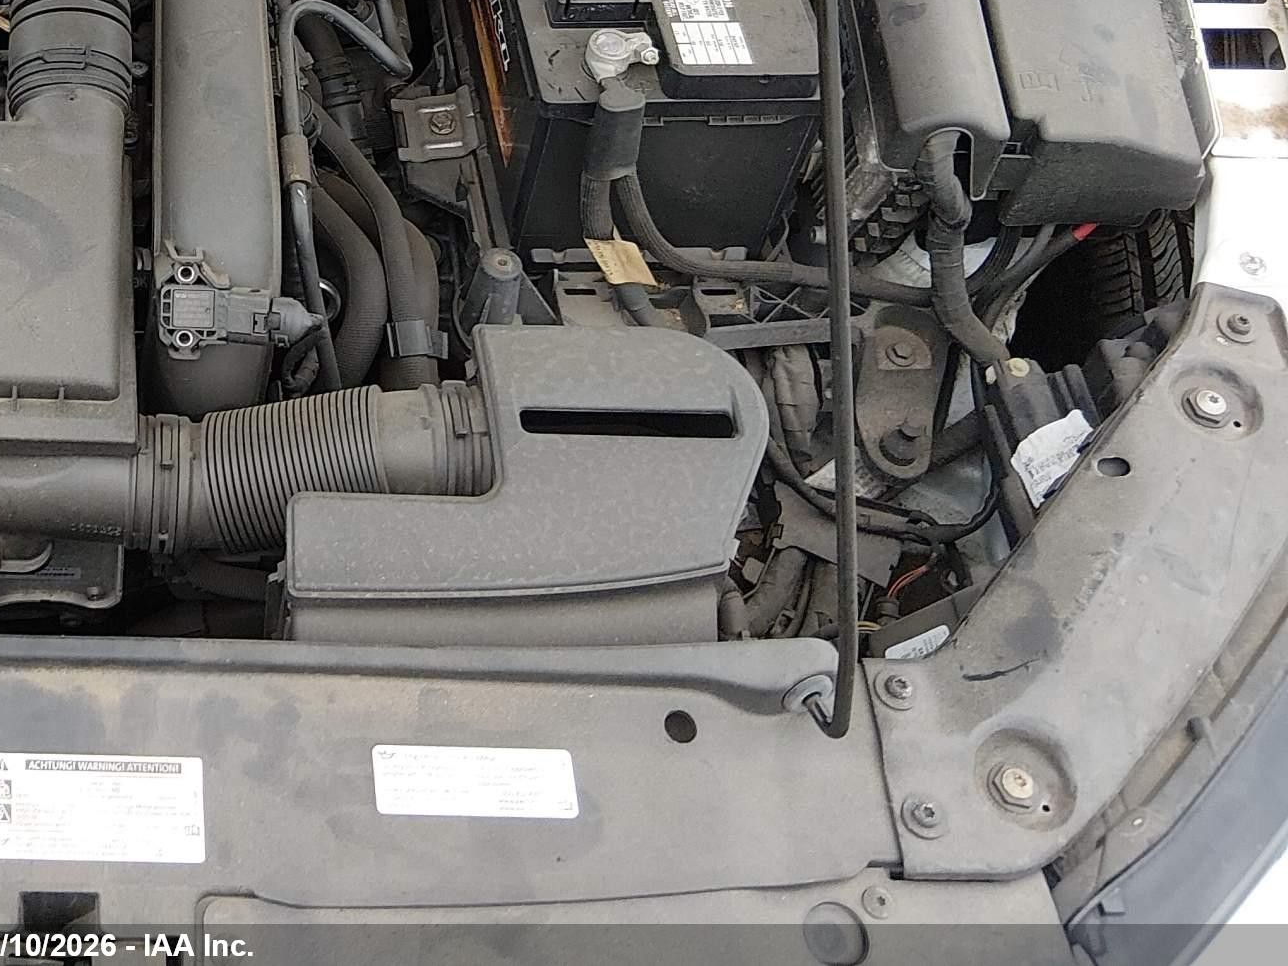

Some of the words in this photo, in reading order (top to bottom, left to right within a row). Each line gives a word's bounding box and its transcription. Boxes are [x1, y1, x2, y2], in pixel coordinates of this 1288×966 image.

[28, 759, 77, 772] ACHTUNG!
[77, 760, 126, 773] WARNING!
[126, 762, 180, 774] ATTENTION!
